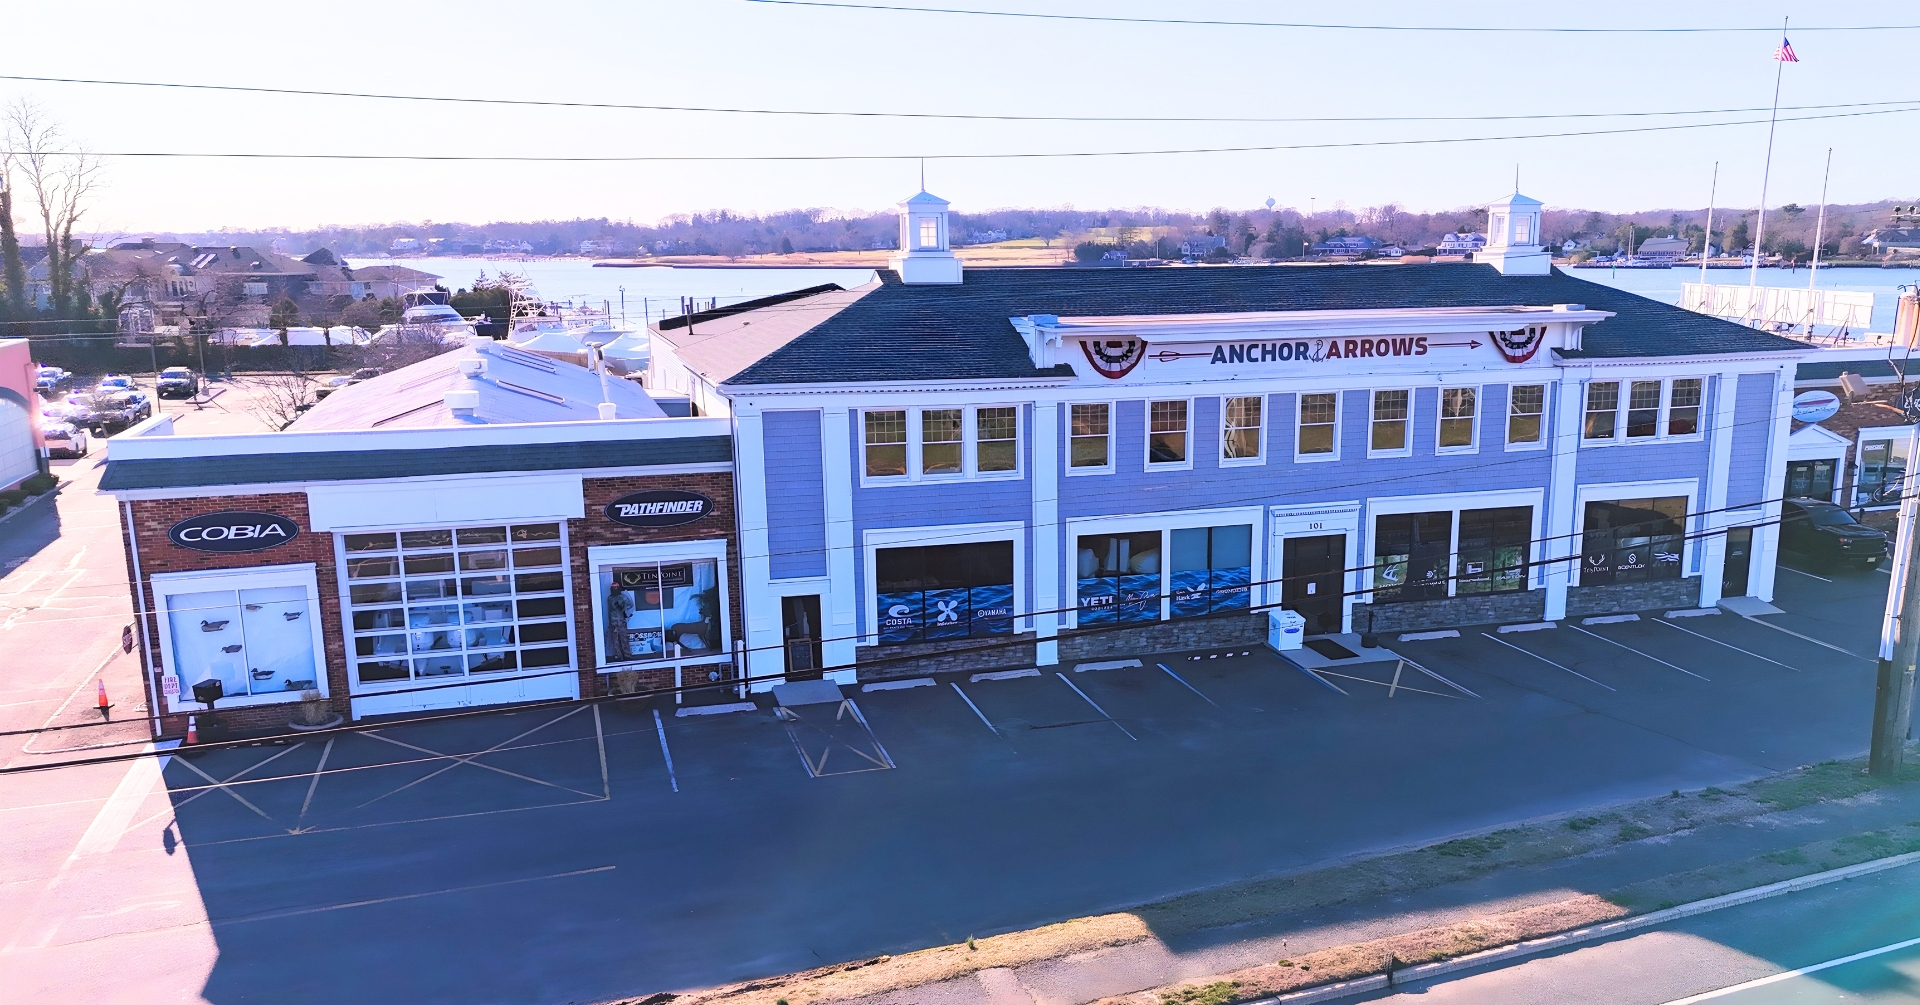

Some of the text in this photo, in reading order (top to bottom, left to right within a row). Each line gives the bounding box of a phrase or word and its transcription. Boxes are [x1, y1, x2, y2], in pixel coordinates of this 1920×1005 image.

[1210, 337, 1428, 364] ANCHOR ARROWS
[615, 500, 703, 517] PATHFINDER
[1309, 522, 1323, 530] 101
[179, 523, 287, 541] COBIA
[641, 570, 683, 580] TENOINT
[1081, 595, 1114, 607] YETI
[984, 609, 1007, 617] YAMAHA
[885, 617, 912, 626] COSTA
